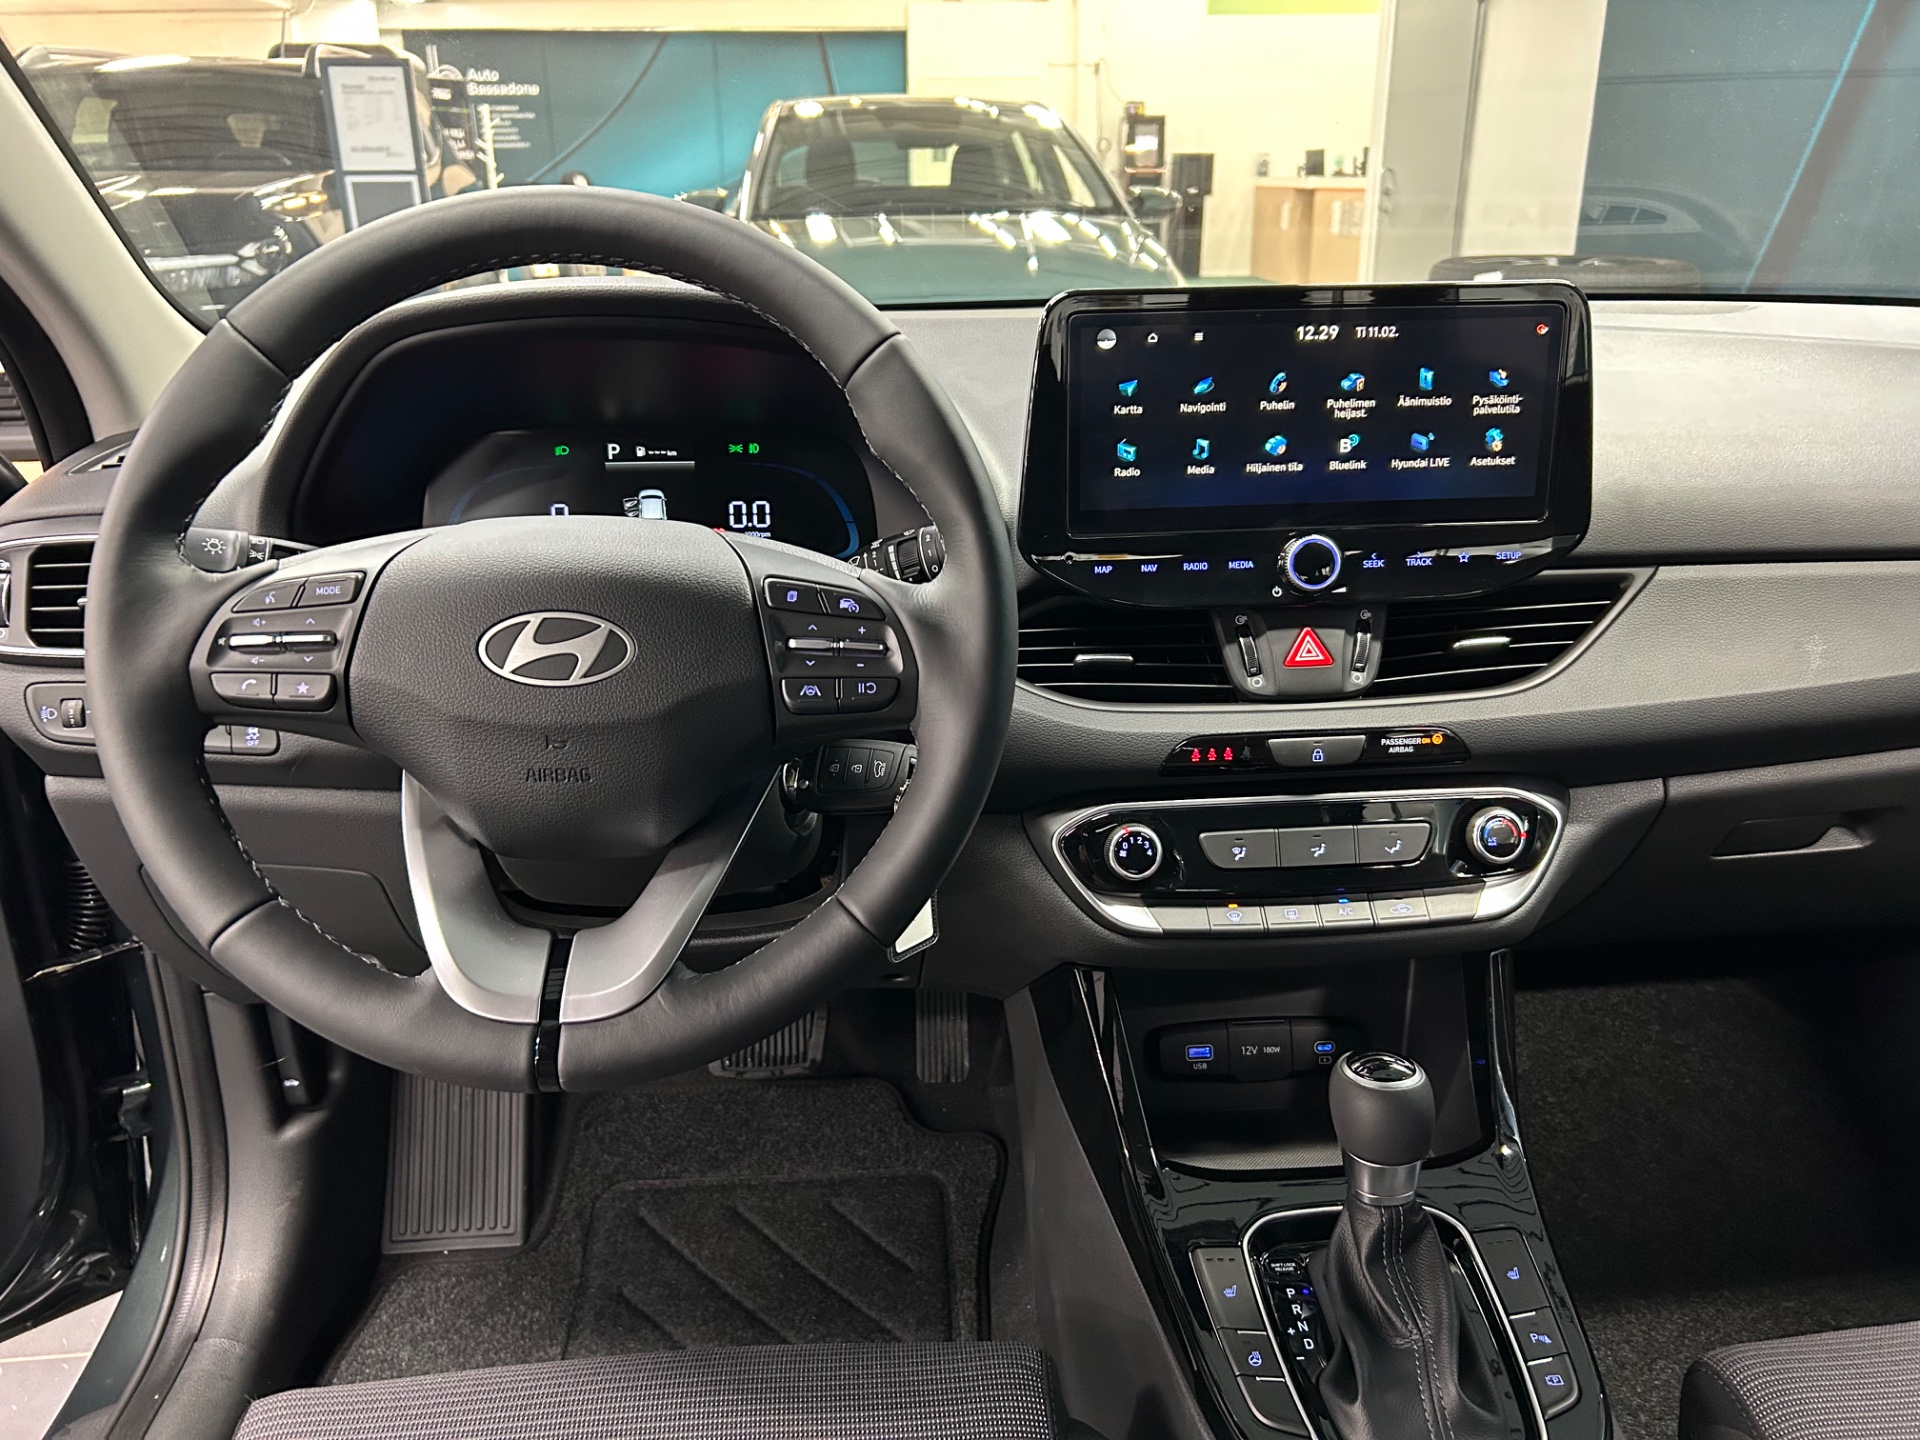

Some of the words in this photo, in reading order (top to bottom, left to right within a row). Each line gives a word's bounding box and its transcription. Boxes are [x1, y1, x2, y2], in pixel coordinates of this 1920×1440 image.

[466, 68, 500, 82] Auto
[1296, 324, 1340, 341] 12.29
[1259, 400, 1296, 411] Puhelin
[1326, 398, 1376, 409] Puhelimen
[1397, 394, 1453, 407] Äänimuistio
[1113, 404, 1143, 415] Kartta
[1179, 401, 1227, 414] Navigointi
[1473, 404, 1521, 416] palvelutila
[607, 443, 621, 460] P
[1329, 459, 1368, 471] Bluelink
[1390, 457, 1429, 470] Hyundai
[1430, 457, 1451, 468] LIVE
[1469, 455, 1516, 467] Asetukset
[1113, 467, 1141, 478] Radio
[1187, 464, 1216, 475] Media
[1245, 462, 1286, 475] Hiljainen
[1287, 461, 1304, 472] tila
[728, 500, 771, 529] 0.0
[1496, 551, 1522, 561] SETUP
[1183, 561, 1209, 571] RADIO
[1228, 560, 1254, 570] MEDIA
[1362, 559, 1385, 569] SEEK
[1405, 557, 1433, 567] TRACK
[1094, 565, 1113, 575] MAP
[1140, 563, 1158, 573] NAV
[315, 585, 341, 596] MODE
[1380, 737, 1421, 746] PASSENGER
[1388, 746, 1414, 754] AIRBAG
[525, 767, 592, 783] AIRBAG
[1338, 907, 1354, 916] A/C
[1241, 1045, 1259, 1055] 12V
[1192, 1062, 1208, 1070] USB
[1285, 1287, 1296, 1299] P
[1291, 1304, 1302, 1316] R
[1296, 1320, 1309, 1333] N
[1303, 1338, 1315, 1350] D
